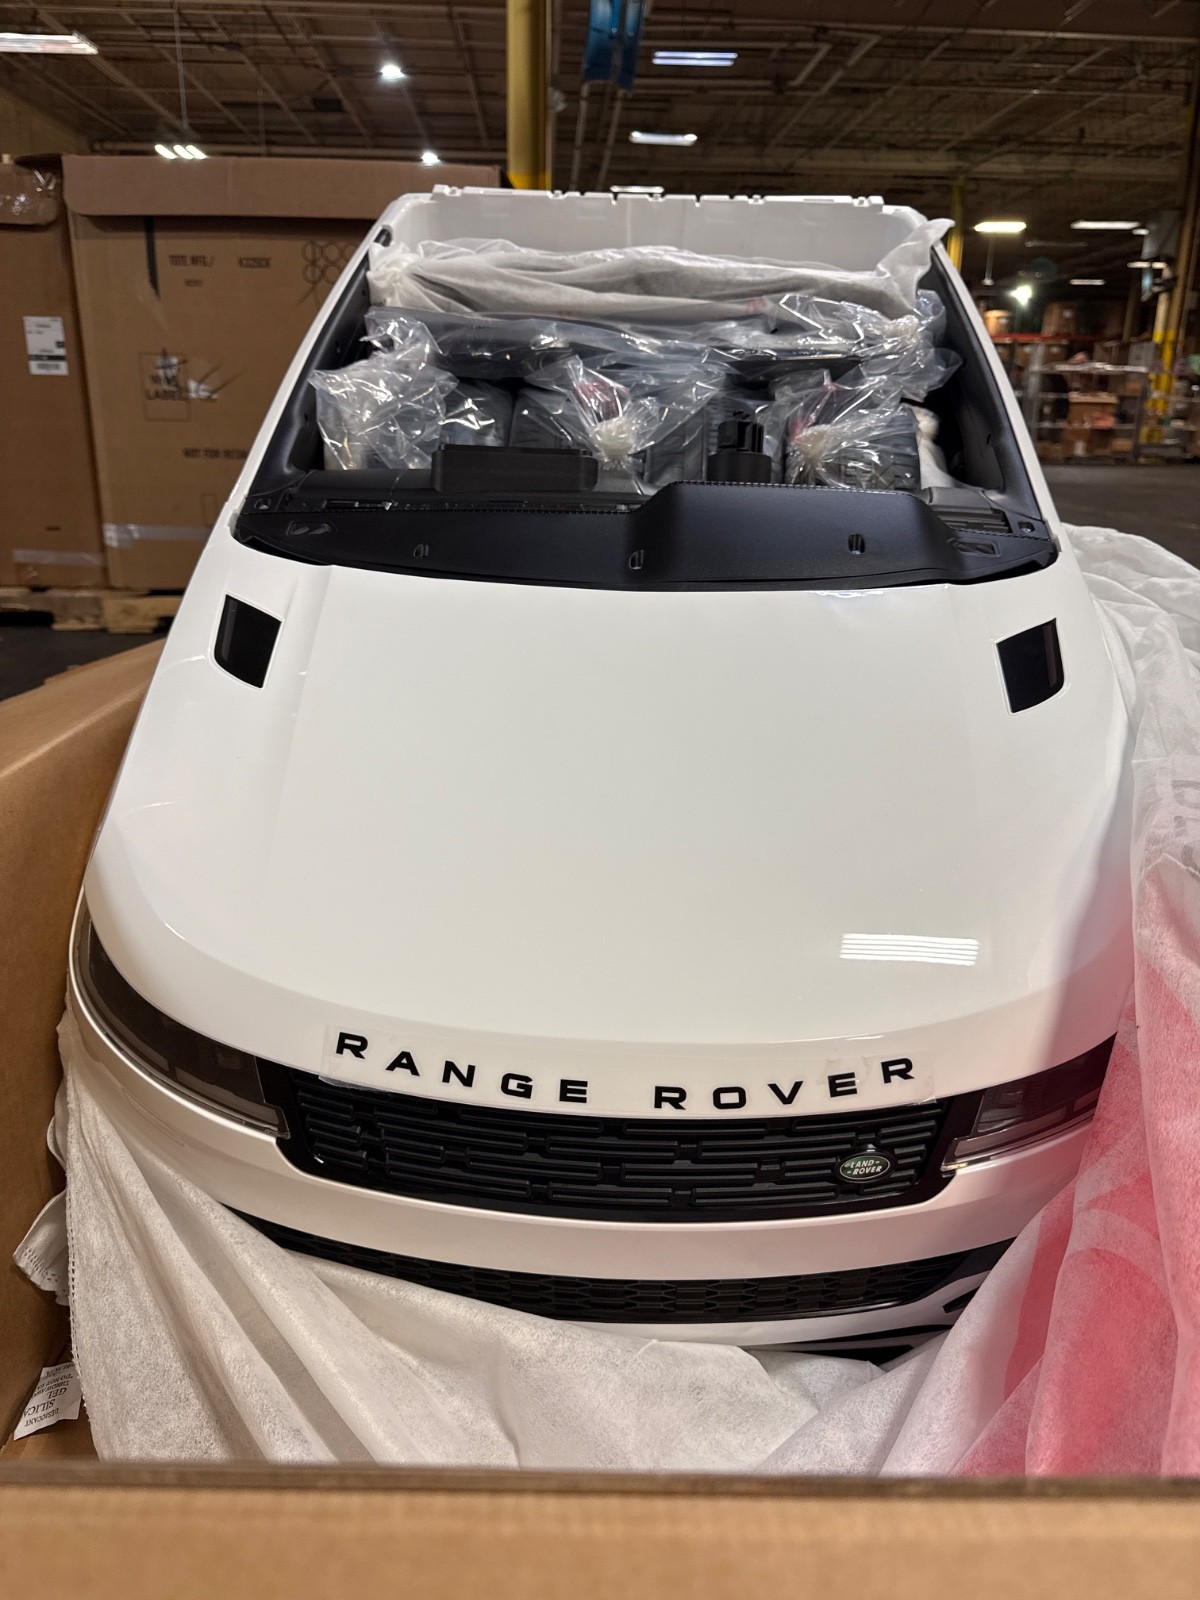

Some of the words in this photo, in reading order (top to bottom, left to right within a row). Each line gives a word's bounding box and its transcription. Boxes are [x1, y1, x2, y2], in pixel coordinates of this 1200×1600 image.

[336, 1032, 588, 1103] RANGE
[654, 1058, 915, 1110] ROVER
[47, 1387, 67, 1399] GEL
[23, 1399, 55, 1418] SILICA
[25, 1408, 59, 1427] DESICCANT
